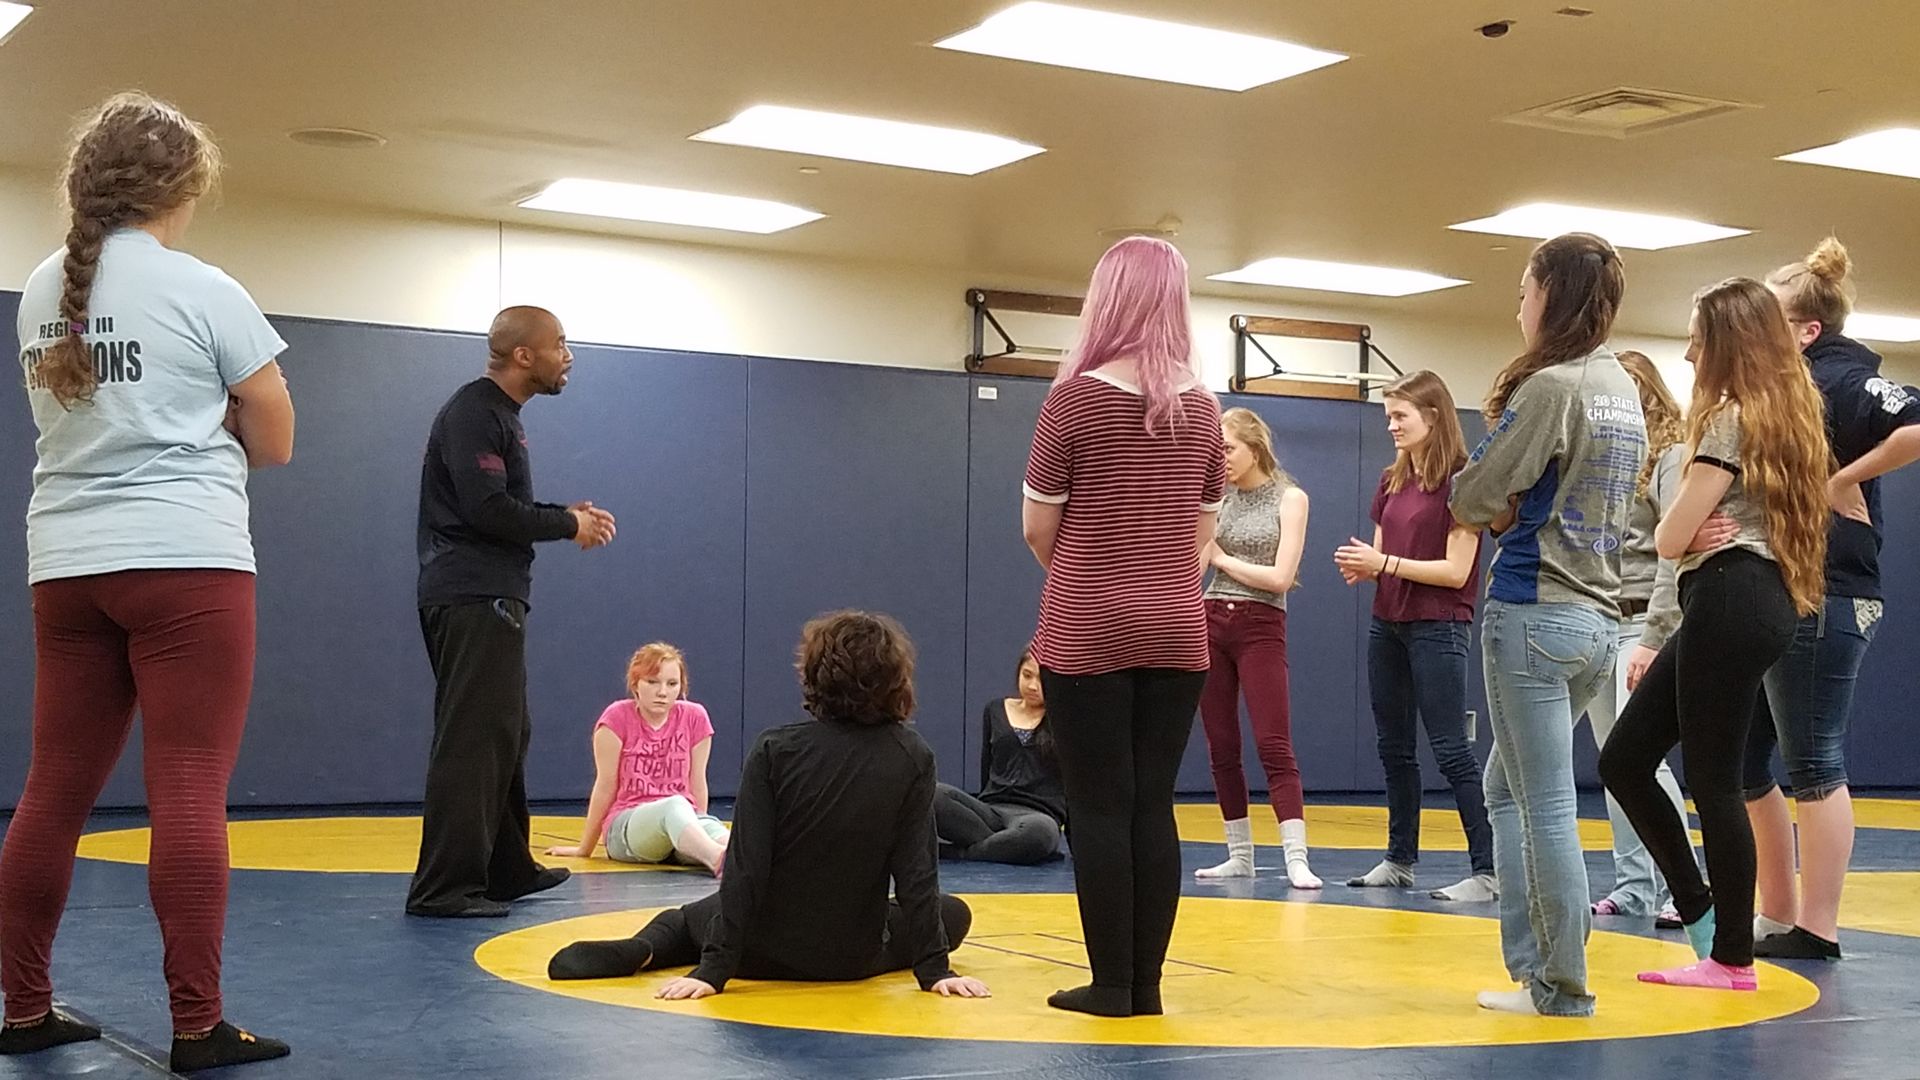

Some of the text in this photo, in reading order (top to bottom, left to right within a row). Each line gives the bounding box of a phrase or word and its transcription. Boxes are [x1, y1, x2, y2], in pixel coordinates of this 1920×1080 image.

[39, 317, 113, 339] REGIN III
[1612, 396, 1635, 412] STATE
